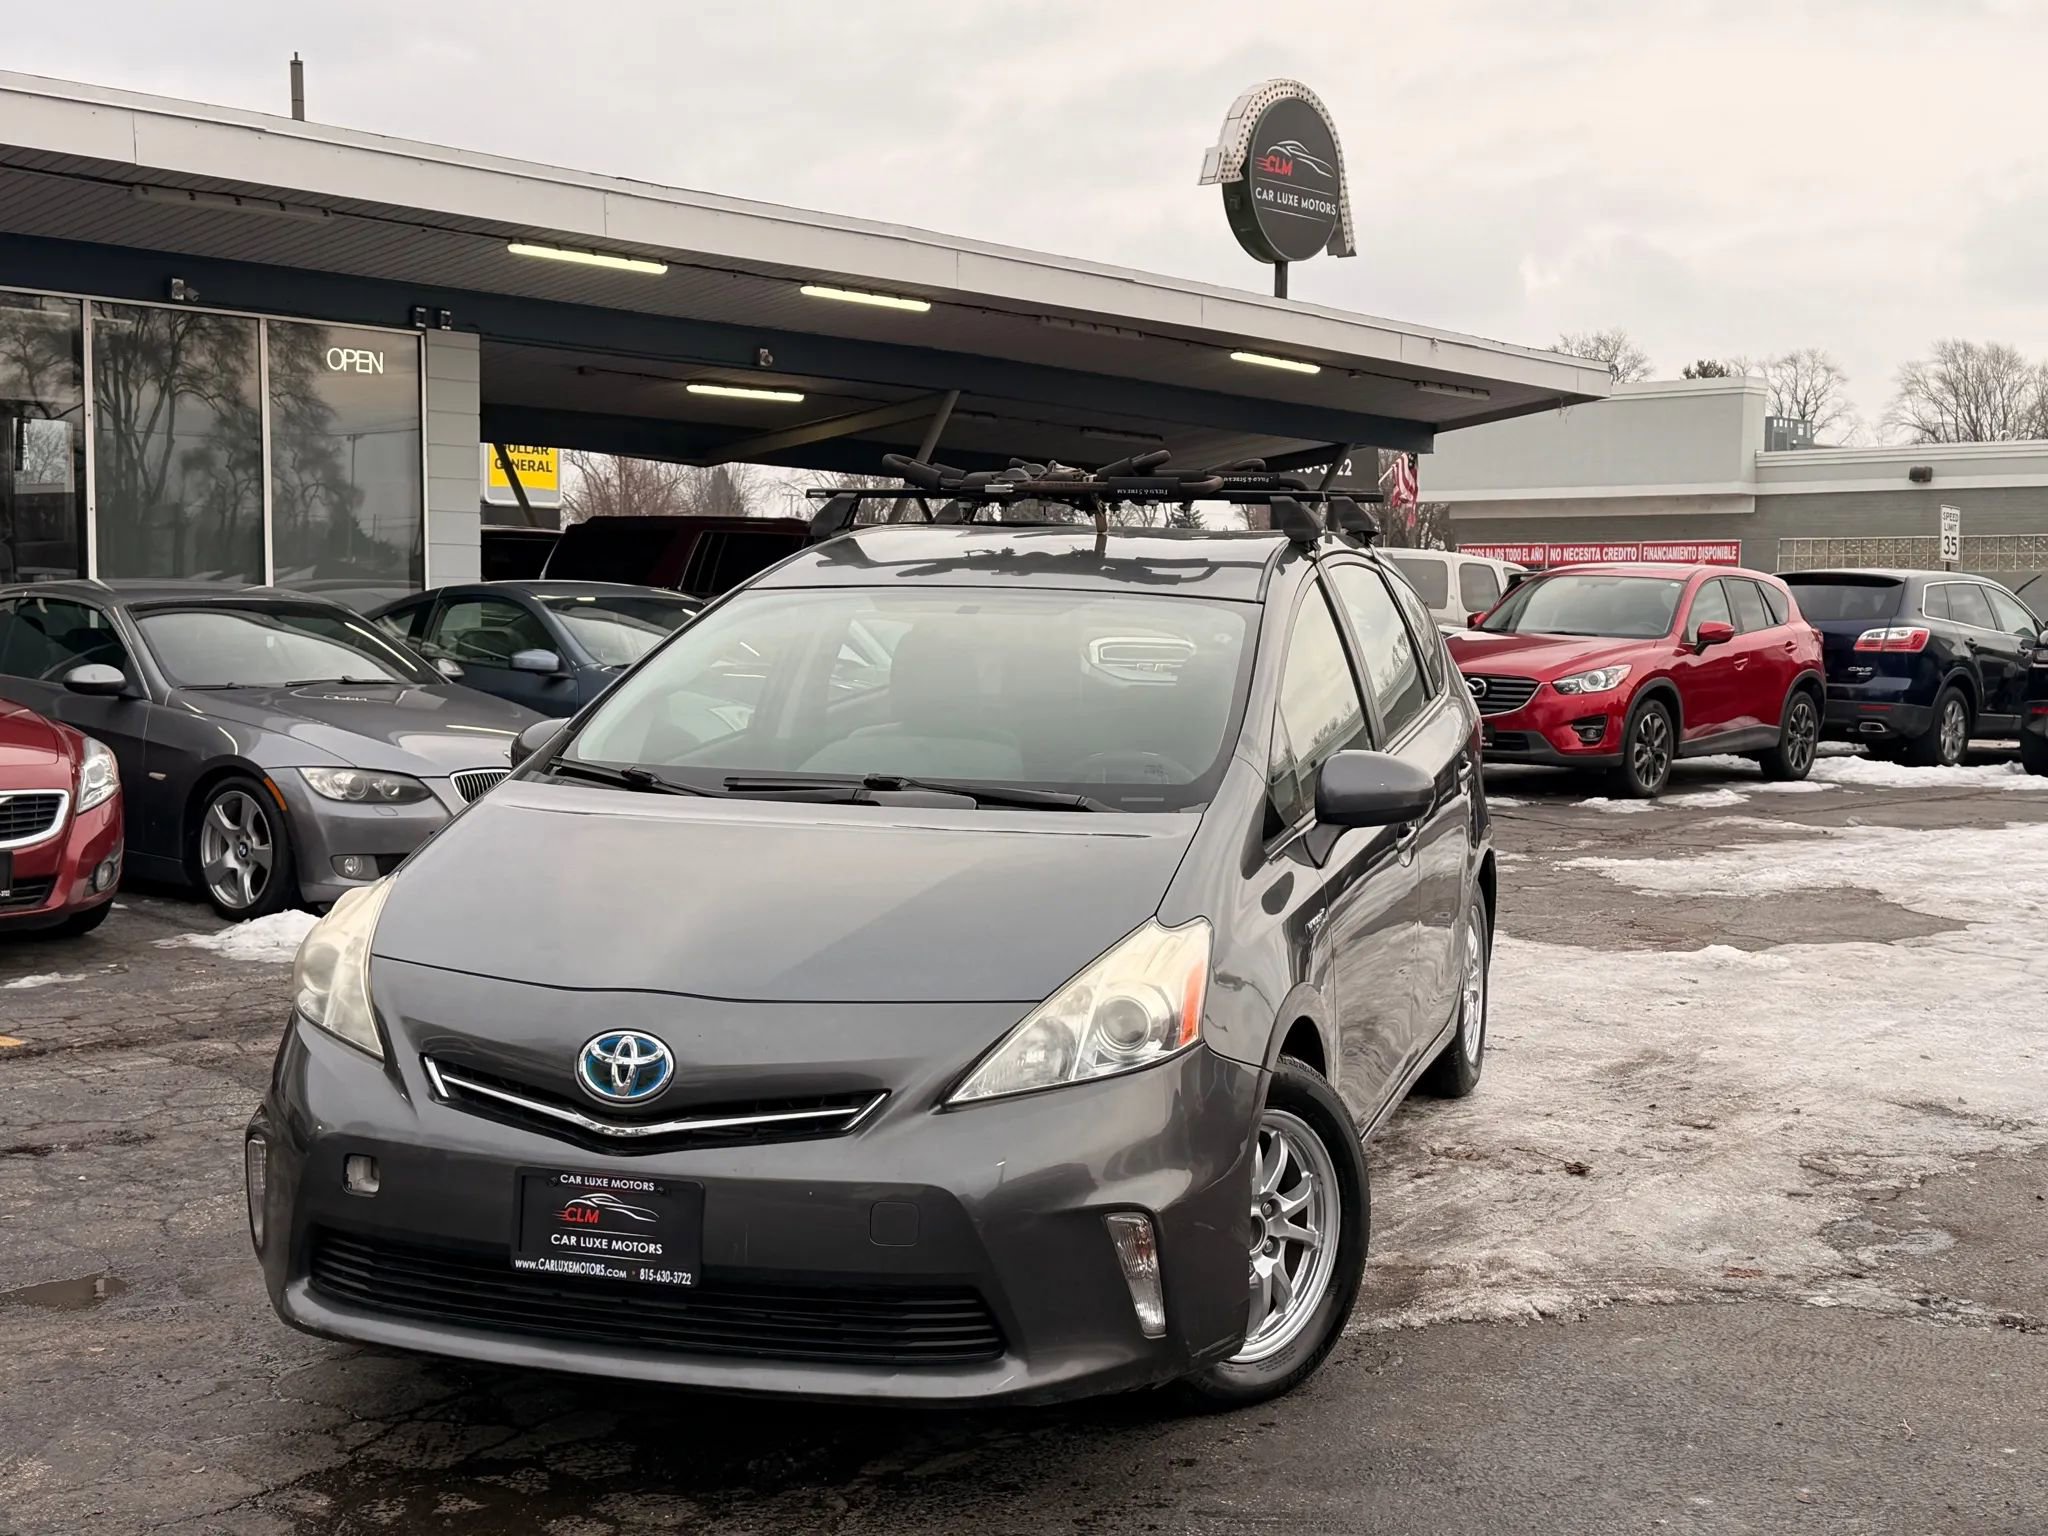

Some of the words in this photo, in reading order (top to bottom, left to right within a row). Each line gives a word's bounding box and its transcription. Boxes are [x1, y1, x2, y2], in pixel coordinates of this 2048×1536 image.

[1265, 155, 1293, 176] CLM
[1255, 187, 1274, 202] CAR
[1277, 191, 1299, 207] LUXE
[1301, 198, 1337, 216] MOTORS
[326, 347, 384, 375] OPEN
[505, 445, 549, 455] OLLAR
[494, 457, 553, 473] GNERAL
[1942, 511, 1959, 522] SPEED
[1505, 547, 1521, 560] TODO
[1522, 547, 1530, 560] EL
[1530, 546, 1544, 560] AÑO
[1550, 547, 1561, 561] NO
[1563, 547, 1600, 561] NECESITA
[1602, 547, 1638, 560] CREDITO
[1643, 546, 1697, 560] FINANCIAMIENTO
[1698, 545, 1737, 560] DISPONIBLE
[1943, 535, 1958, 556] 35
[560, 1174, 582, 1185] CAR
[584, 1177, 609, 1188] LUXE
[611, 1180, 655, 1192] MOTORS
[565, 1207, 600, 1224] CLM
[550, 1234, 577, 1247] CAR
[580, 1237, 609, 1249] LUXE
[611, 1240, 663, 1255] MOTORS
[639, 1267, 692, 1285] 815-630-3722
